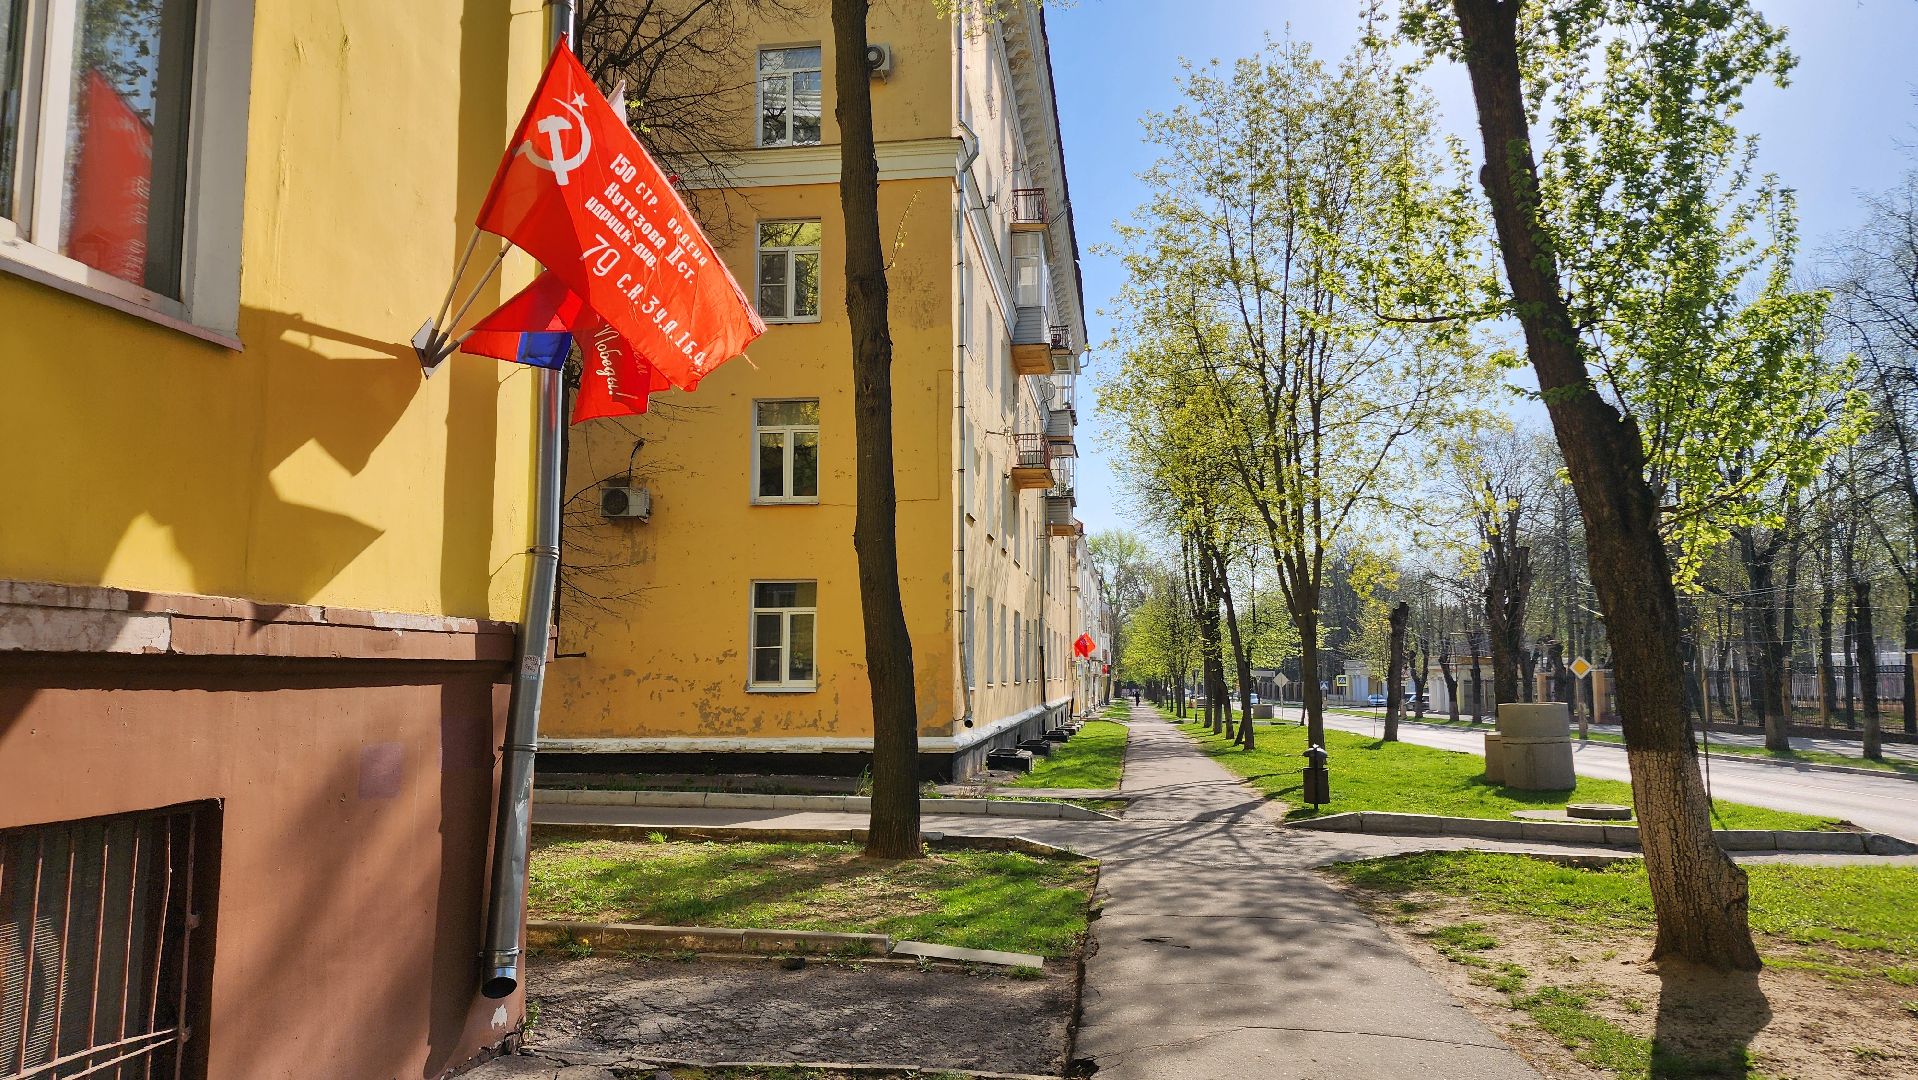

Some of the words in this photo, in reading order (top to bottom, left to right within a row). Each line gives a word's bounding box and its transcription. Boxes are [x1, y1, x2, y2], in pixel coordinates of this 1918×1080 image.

[609, 152, 637, 184] 150
[579, 233, 621, 277] 79
[594, 324, 639, 400] Победы!
